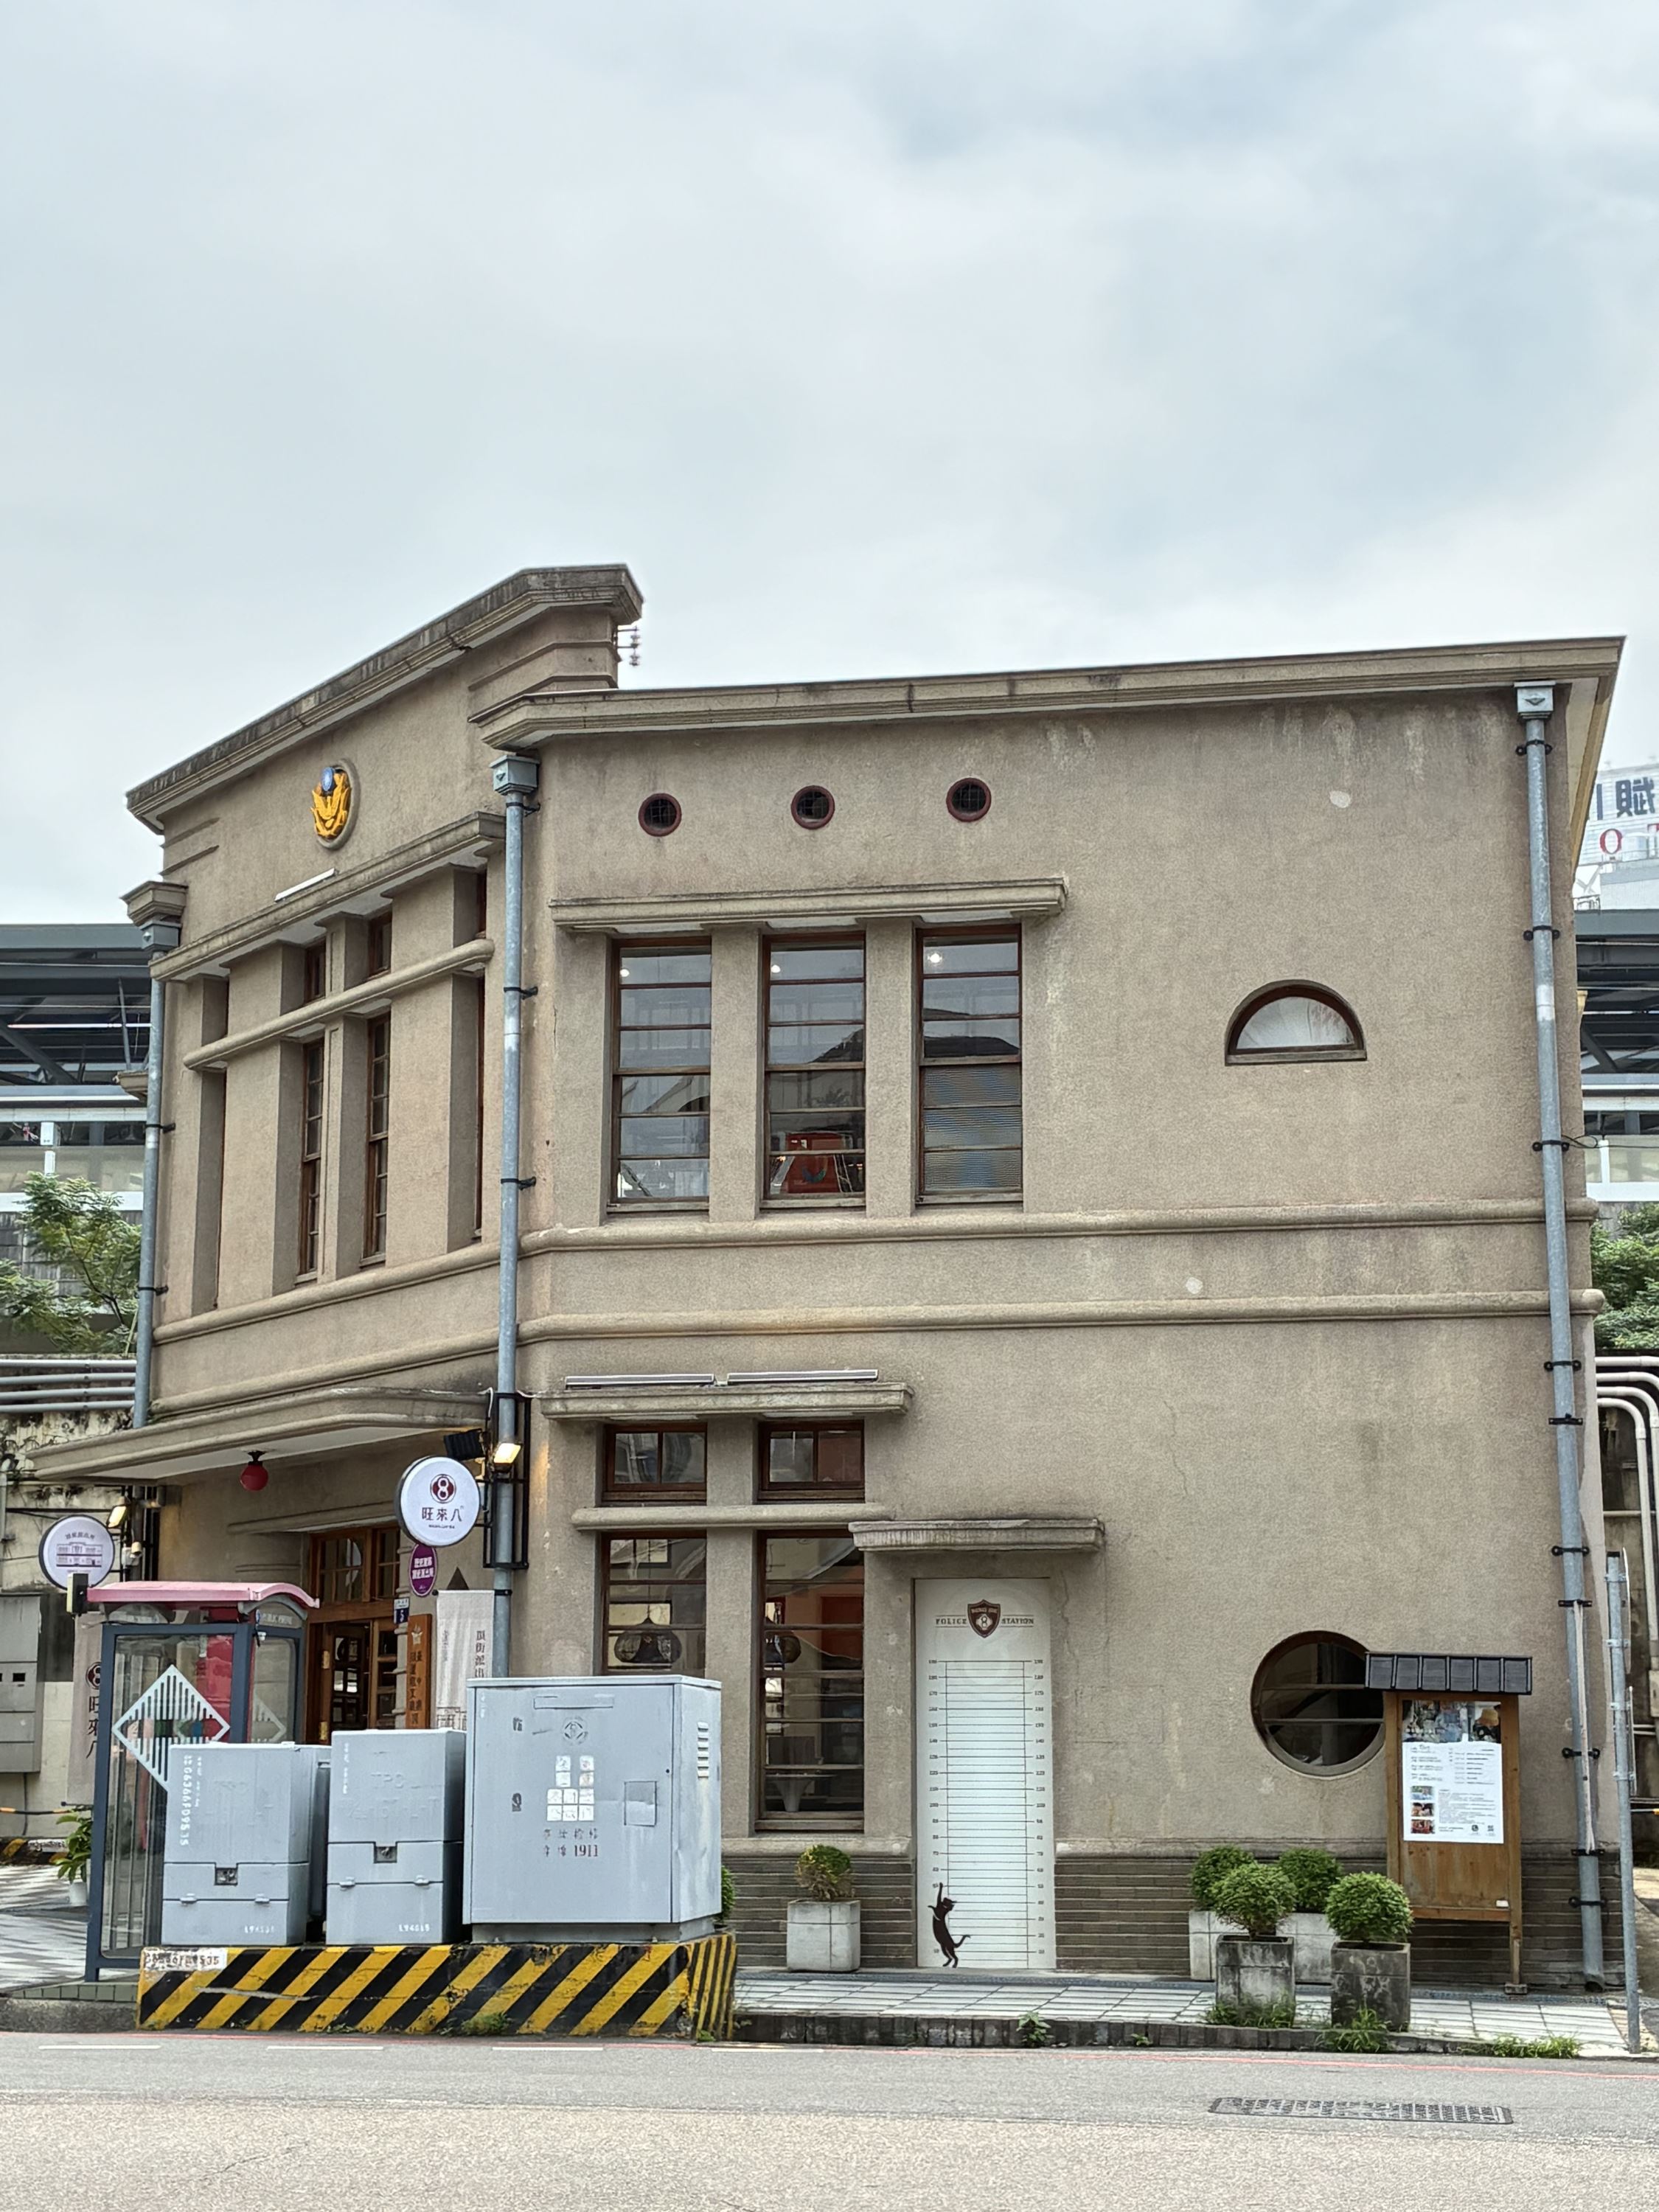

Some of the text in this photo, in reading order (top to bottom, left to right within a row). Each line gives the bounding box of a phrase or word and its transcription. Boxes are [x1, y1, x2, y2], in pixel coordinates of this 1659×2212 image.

[1596, 776, 1656, 821] 賦
[421, 1507, 462, 1522] 旺來八
